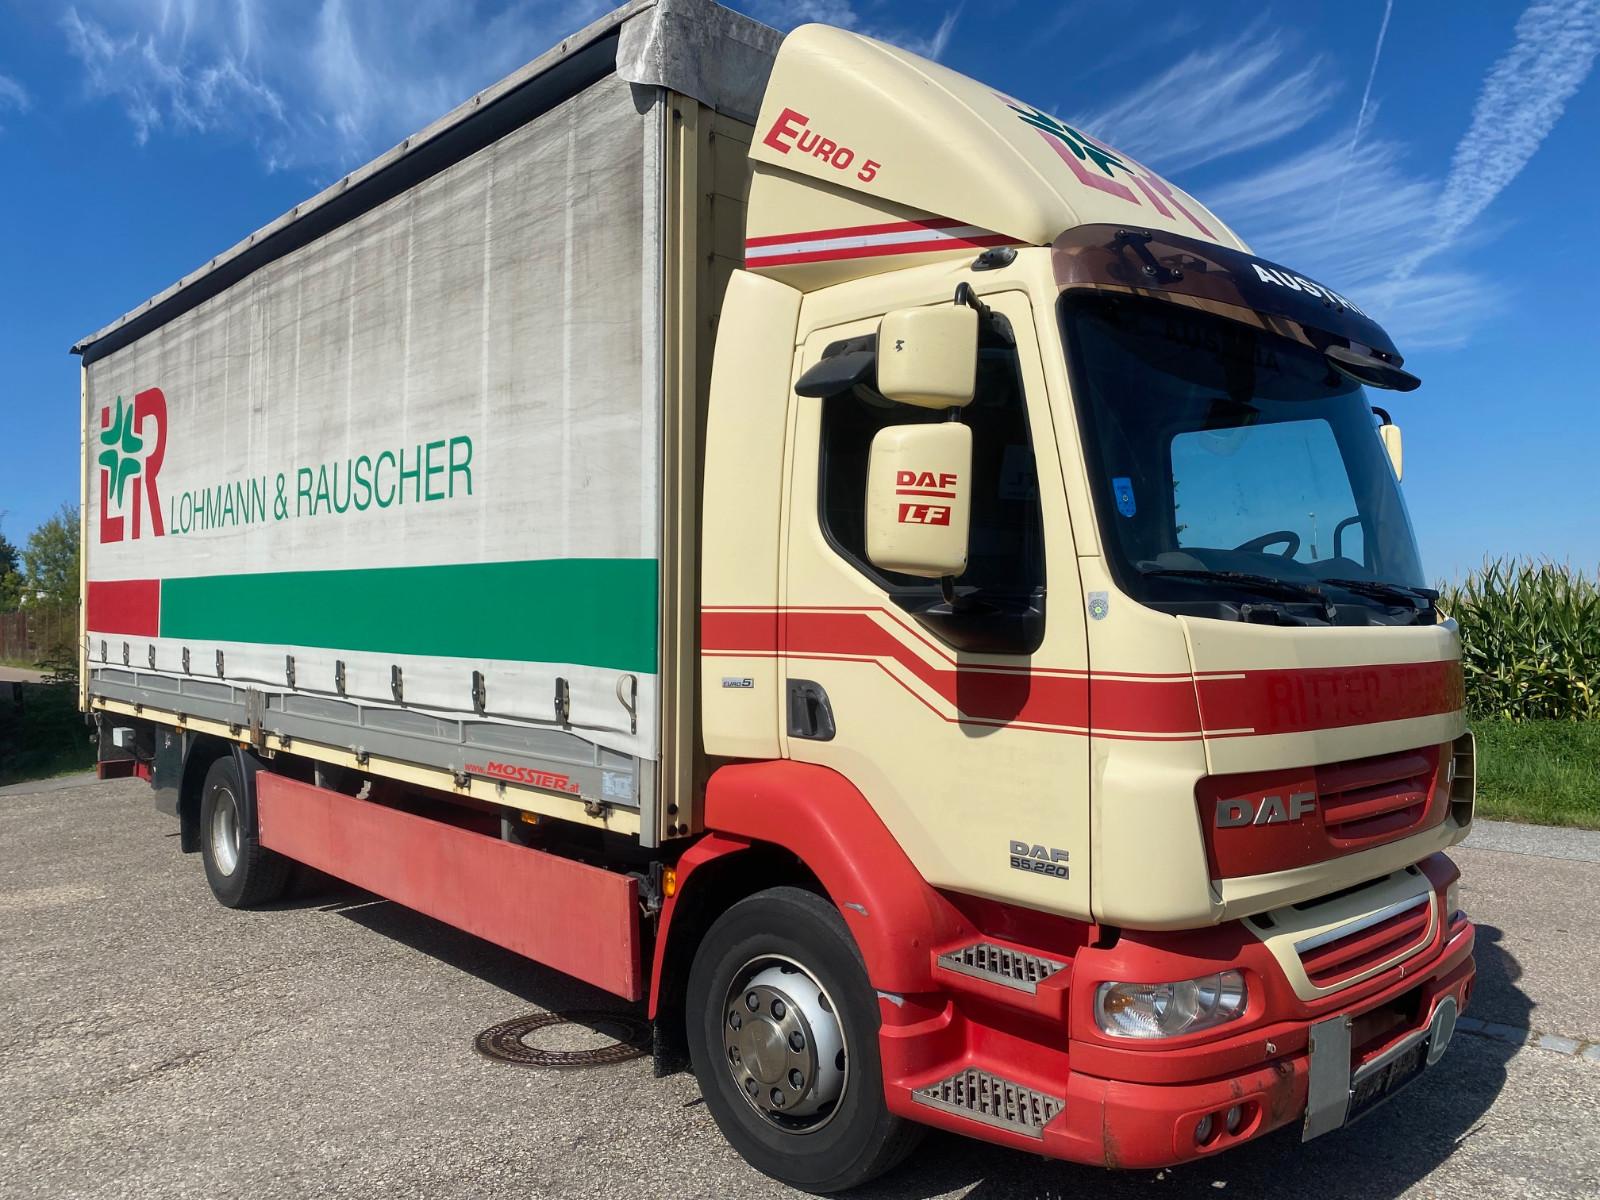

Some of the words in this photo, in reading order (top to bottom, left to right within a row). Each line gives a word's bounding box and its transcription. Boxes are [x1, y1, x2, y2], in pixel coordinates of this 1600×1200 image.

[762, 107, 855, 170] EURO
[857, 159, 882, 183] 5
[1251, 263, 1370, 320] AUSTRI
[170, 475, 266, 535] LOHMANN
[273, 472, 289, 521] &
[297, 434, 473, 518] RAUSCHER
[896, 470, 958, 489] DAF
[904, 505, 946, 524] LF
[1216, 791, 1317, 829] DAF
[1009, 839, 1070, 863] DAF
[1010, 856, 1068, 878] 55.220
